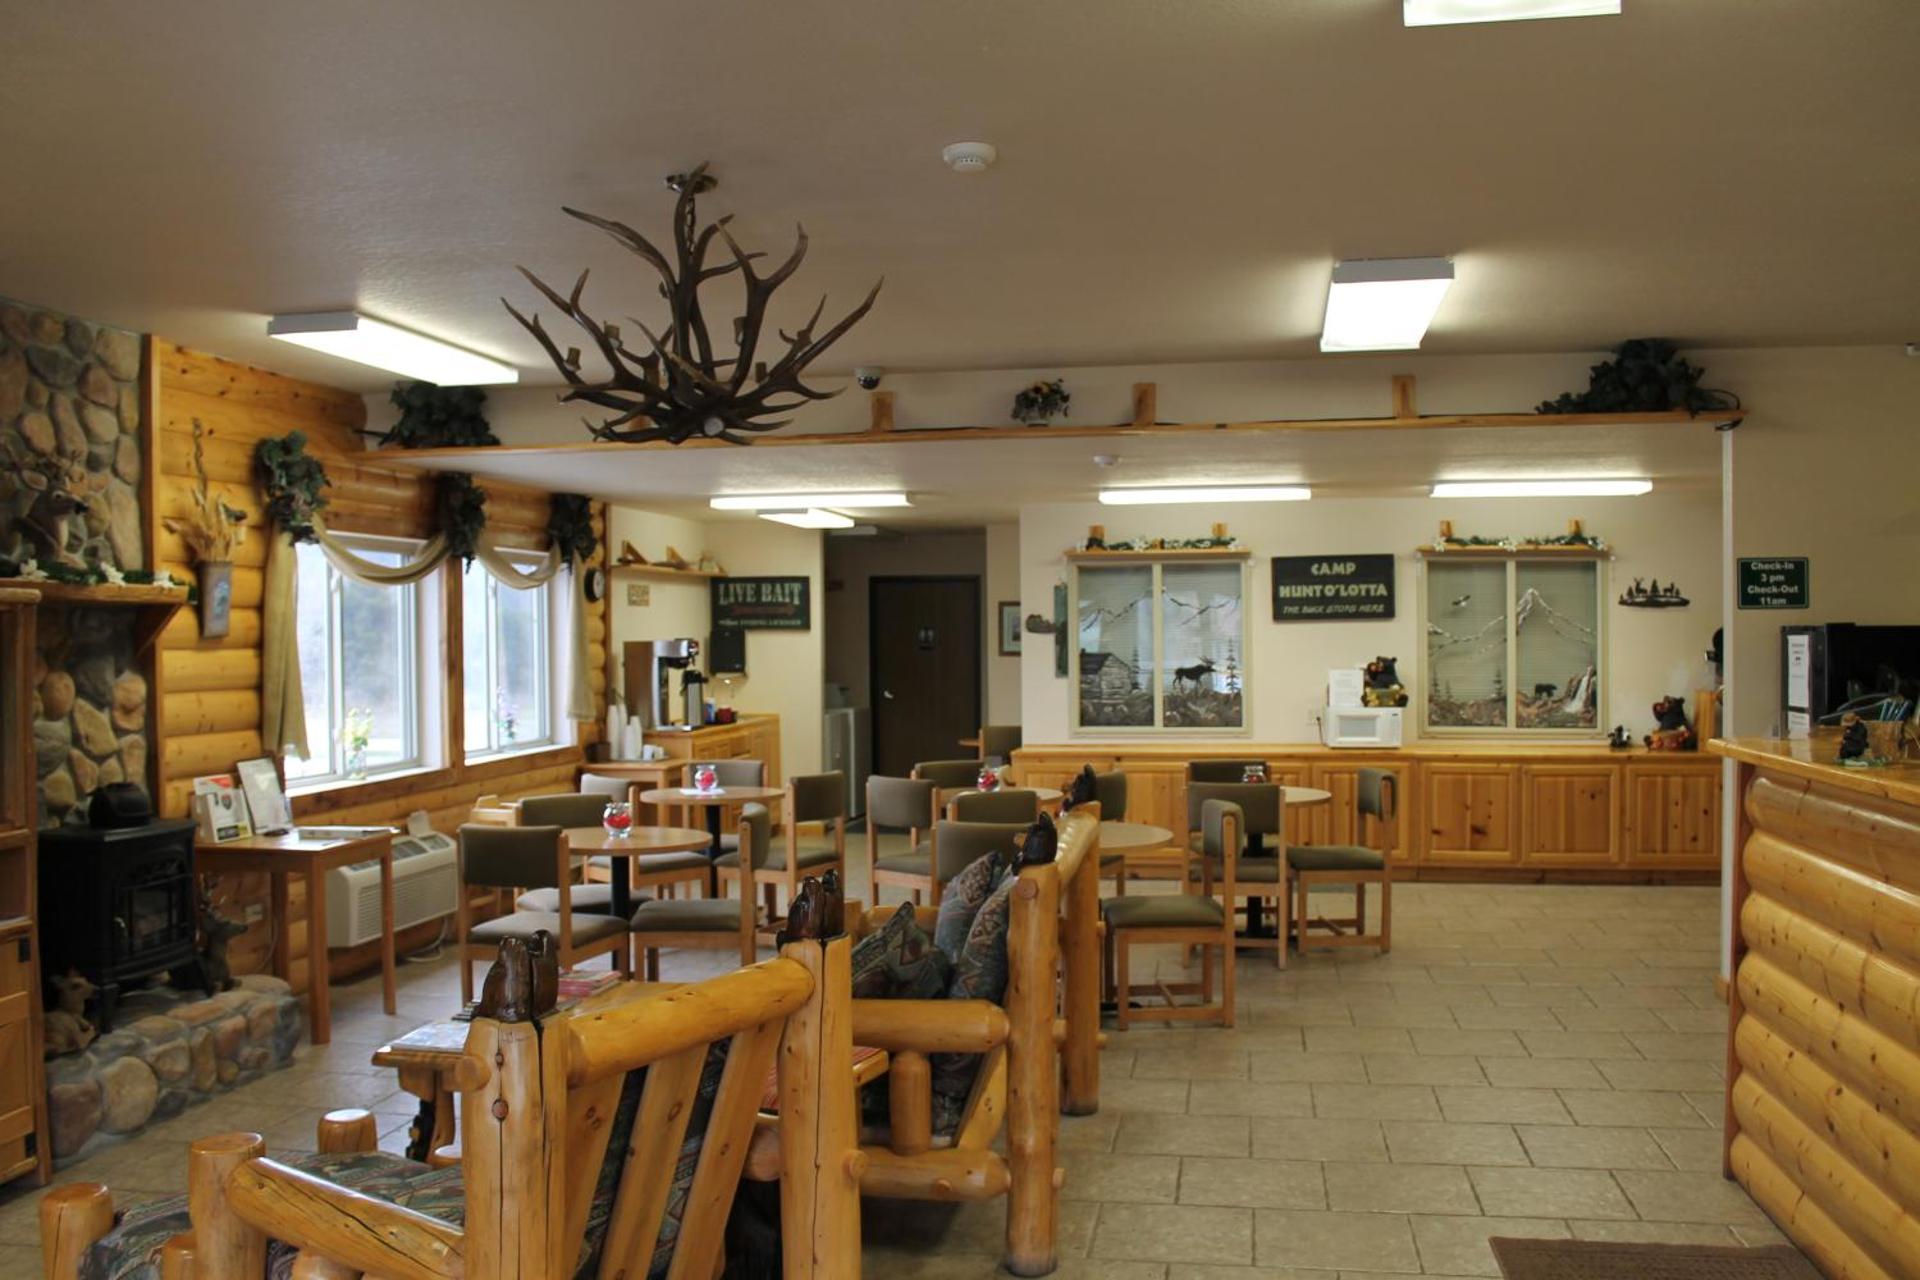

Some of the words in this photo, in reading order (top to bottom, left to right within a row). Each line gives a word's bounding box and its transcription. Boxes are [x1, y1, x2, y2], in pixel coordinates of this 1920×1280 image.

[1311, 562, 1356, 575] CAMP
[1761, 574, 1767, 583] 3
[1769, 574, 1785, 583] pm
[718, 583, 756, 605] LIVE
[761, 583, 802, 605] BAIT
[1747, 585, 1799, 594] Check-Out
